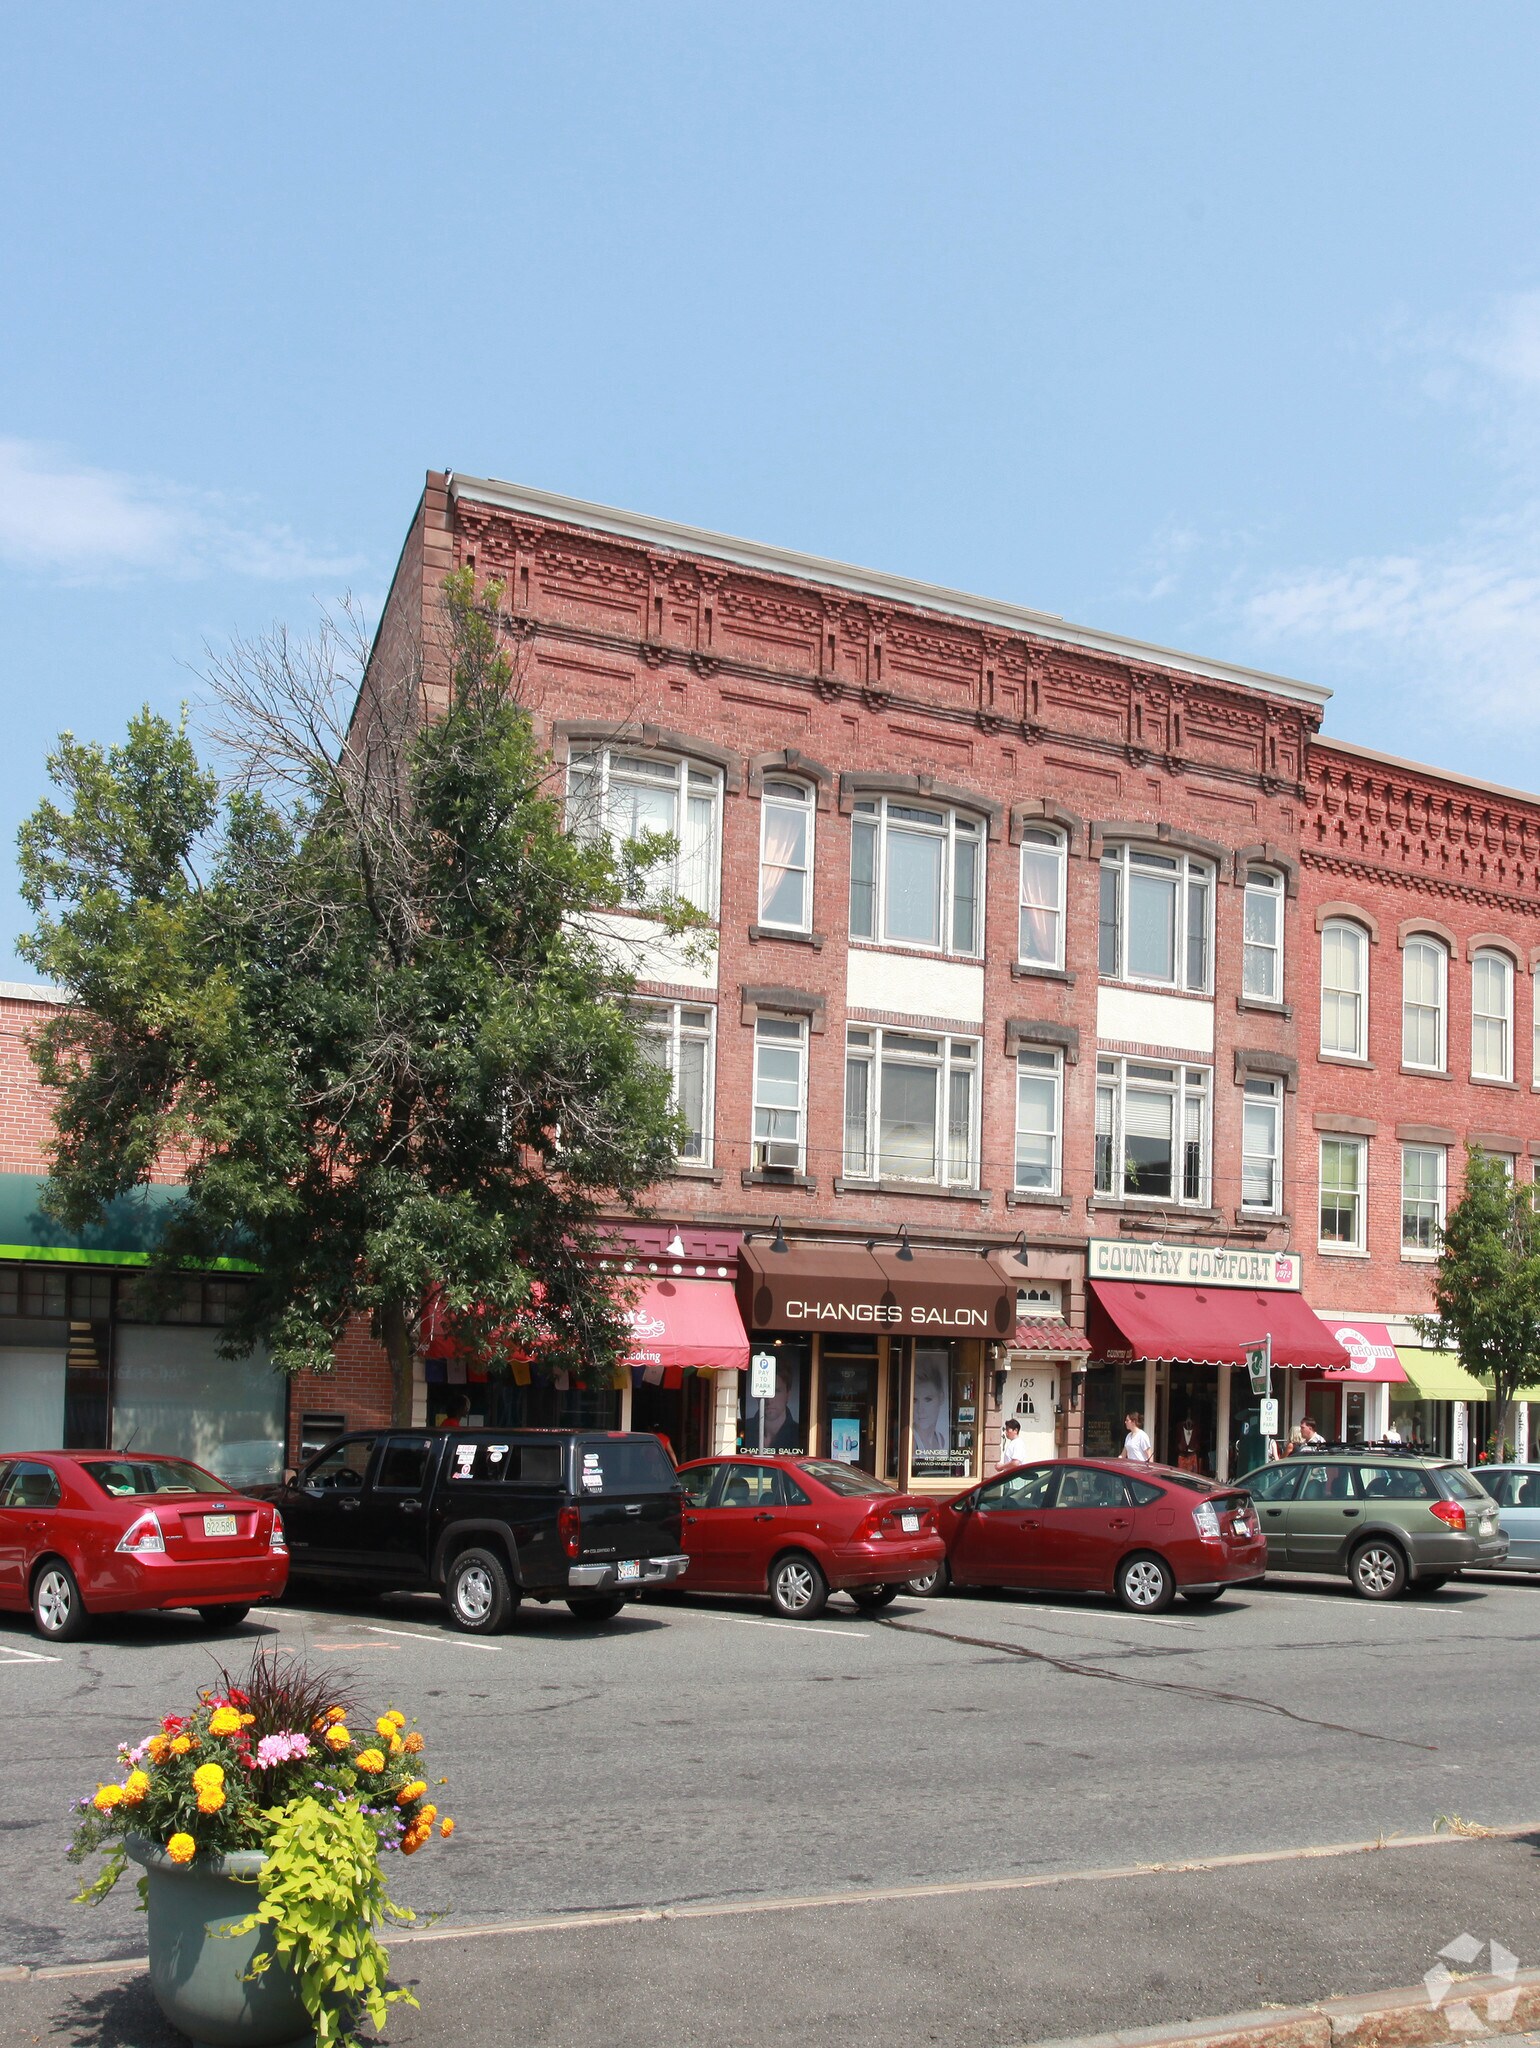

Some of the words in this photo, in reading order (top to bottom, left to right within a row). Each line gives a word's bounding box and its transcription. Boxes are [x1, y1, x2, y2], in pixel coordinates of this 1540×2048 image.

[1098, 1245, 1183, 1275] COUNTRY
[1189, 1251, 1271, 1281] COMFORT
[786, 1300, 903, 1323] CHANGES
[911, 1306, 988, 1326] SALON
[1019, 1378, 1035, 1388] 155
[778, 1447, 804, 1455] SALON
